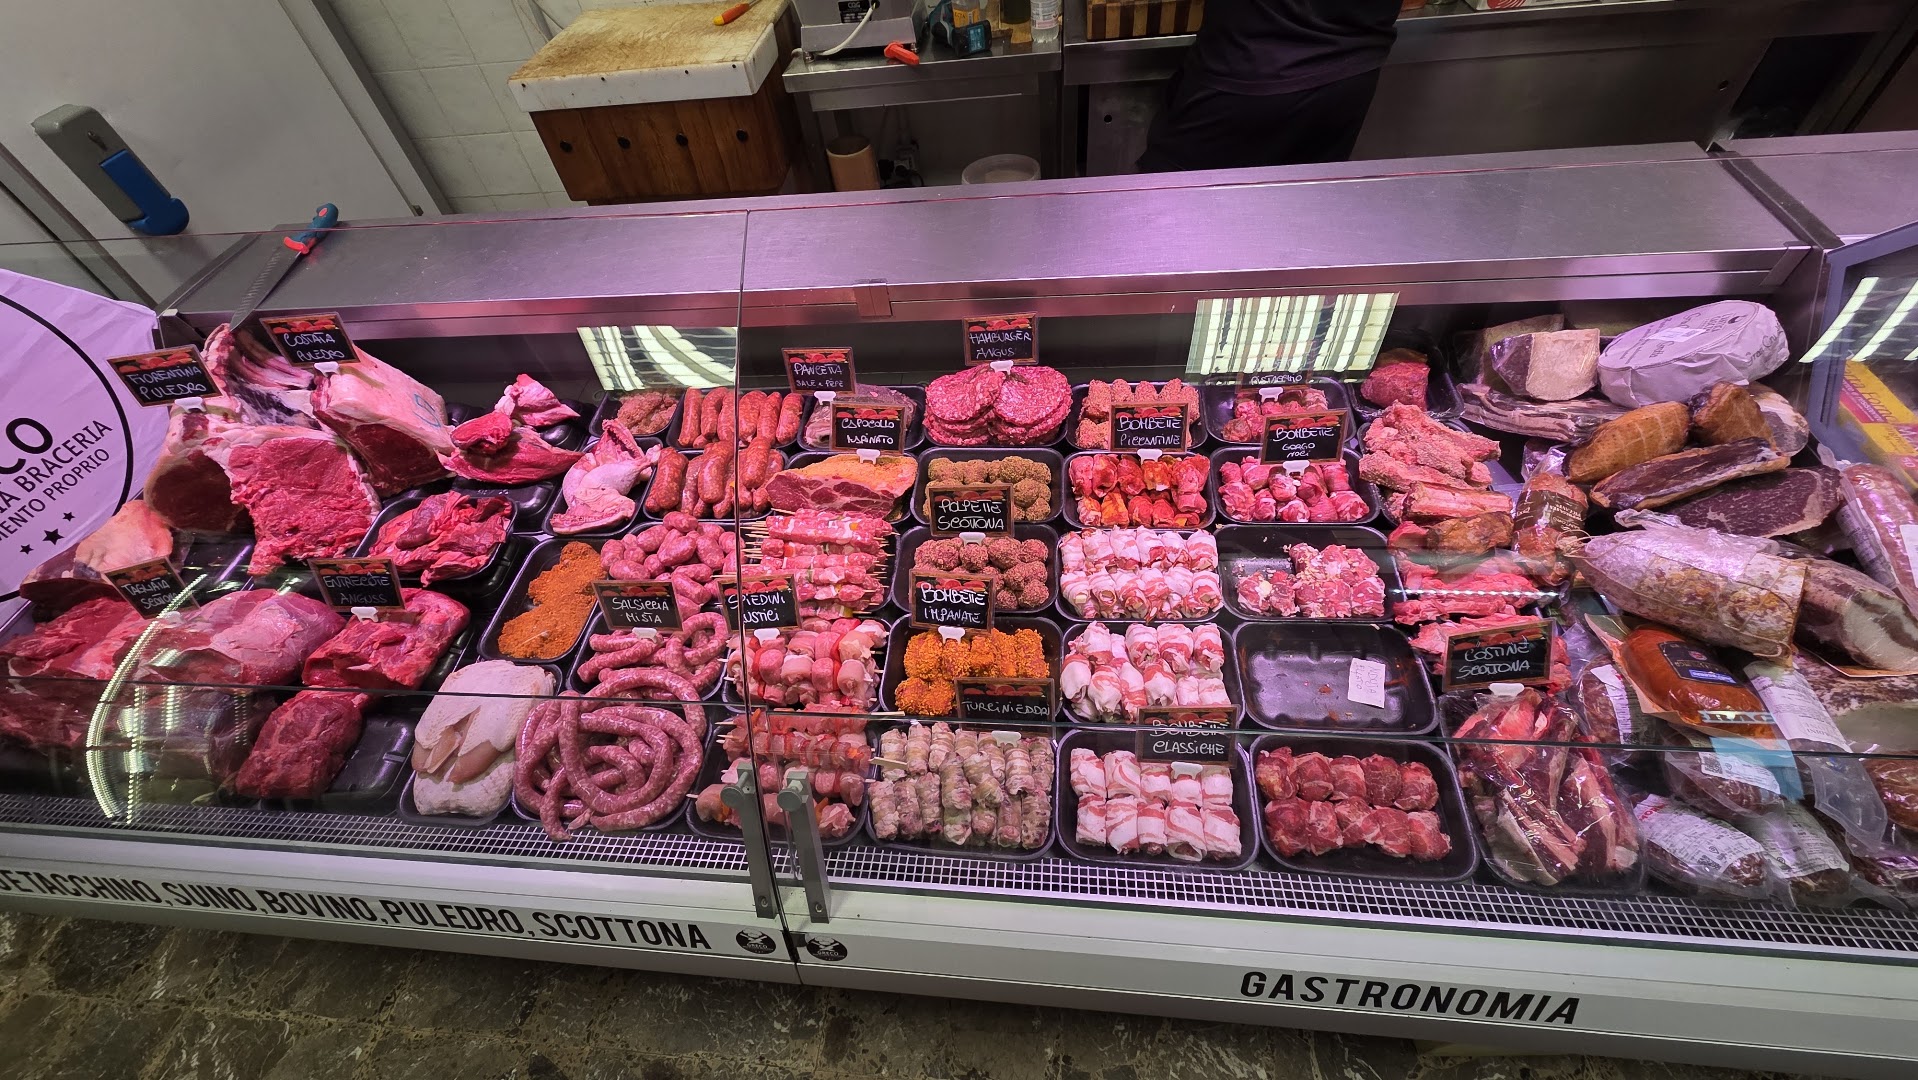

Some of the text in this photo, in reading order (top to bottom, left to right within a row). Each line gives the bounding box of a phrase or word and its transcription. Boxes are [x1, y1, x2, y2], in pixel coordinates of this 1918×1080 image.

[283, 332, 336, 347] COSTATA
[968, 330, 1032, 345] HAMBURGER
[296, 349, 345, 362] PULEDRO
[976, 347, 1015, 359] ANGUS
[125, 365, 202, 385] FIORENTINA
[793, 362, 843, 376] PANCETTA
[139, 382, 207, 400] PULEDRO
[796, 379, 817, 389] SALE
[841, 418, 895, 430] CAPOCOLLO
[1116, 415, 1182, 432] BOMBETTE
[1120, 433, 1181, 446] PICCANTINE
[1272, 426, 1335, 442] BOMBETTE
[1282, 442, 1316, 451] GORGO
[13, 420, 113, 493] BRACERIA
[42, 448, 110, 501] PROPRIO
[939, 499, 1003, 514] POLPETTE
[937, 516, 1005, 530] SCOTTONA
[921, 582, 986, 606] BOMBETTE
[612, 597, 669, 611] SALSICCIA
[625, 612, 662, 624] MISTA
[742, 607, 780, 624] USTICI
[924, 605, 981, 624] IMPANATE
[1464, 640, 1530, 662] COSTINE
[1456, 660, 1530, 679] SCOTTONA
[1153, 740, 1225, 755] CLASSICHE
[1240, 971, 1581, 1025] GASTRONOMIA
